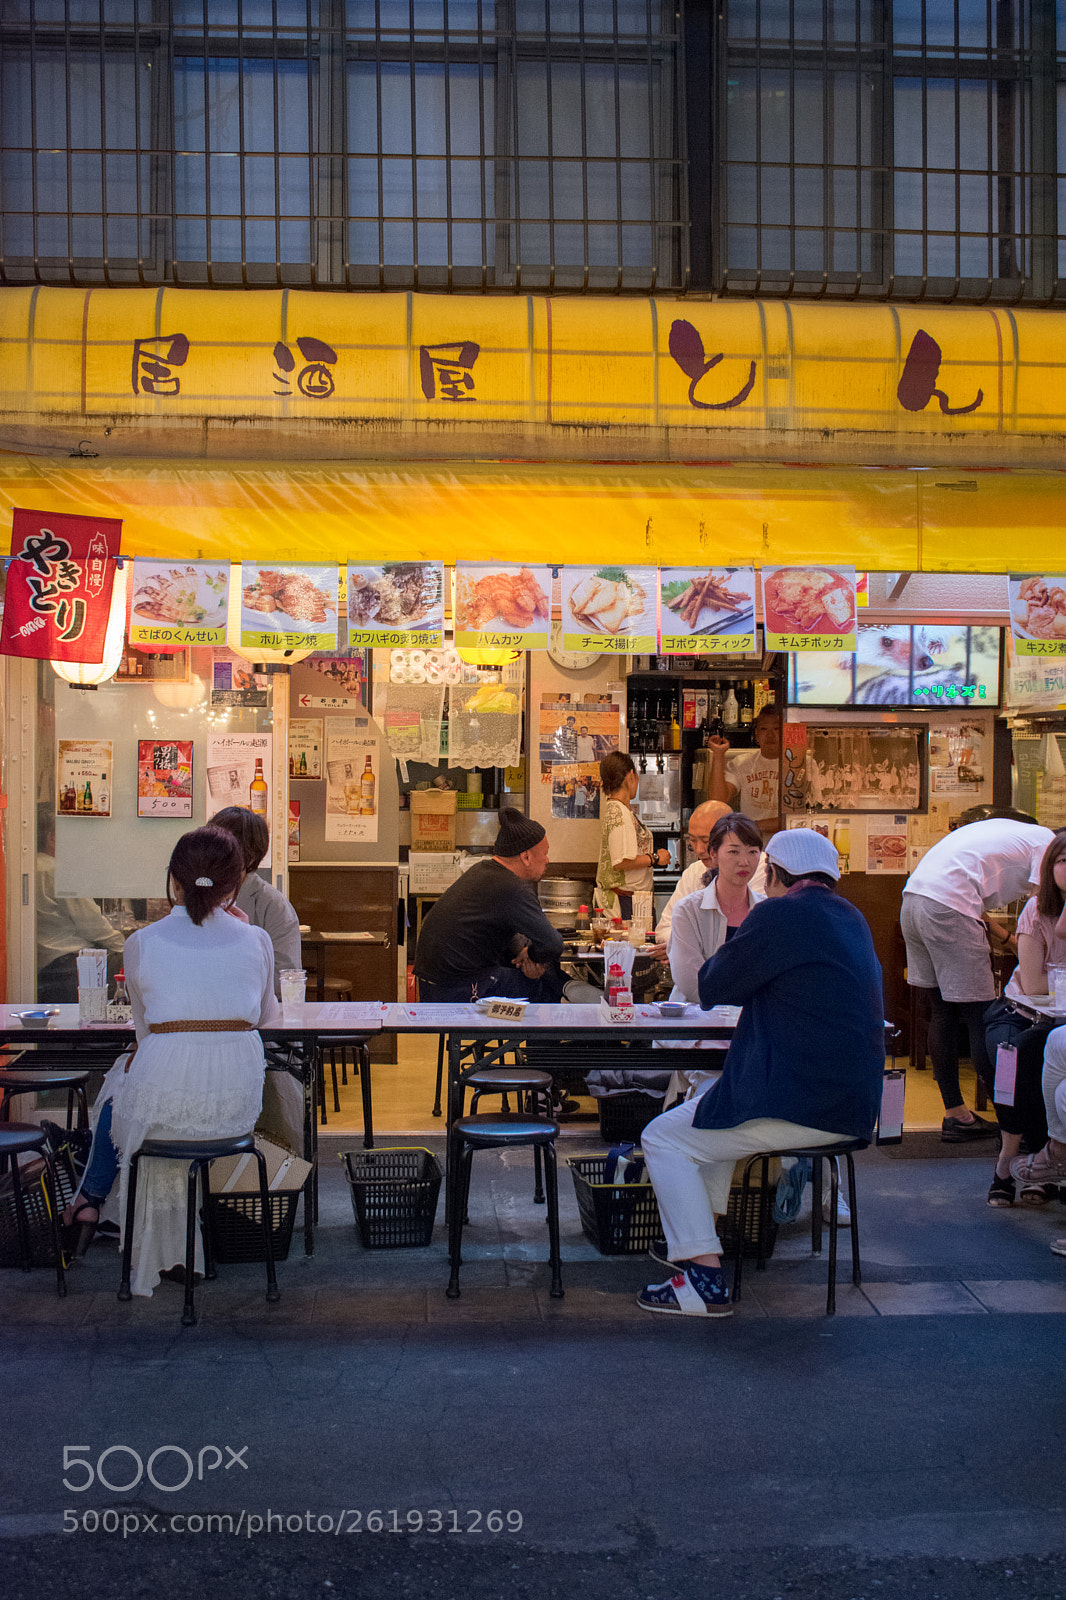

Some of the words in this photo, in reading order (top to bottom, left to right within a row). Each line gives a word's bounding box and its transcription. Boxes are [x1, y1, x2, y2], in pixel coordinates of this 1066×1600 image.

[131, 333, 481, 401] 居酒屋
[90, 541, 105, 588] 味自慢
[18, 528, 86, 642] やきとり
[138, 628, 218, 642] さばのくんせい
[260, 634, 317, 647] ホルモン焼
[352, 632, 439, 645] カワハギの炙り焼き
[478, 634, 524, 646] ハムカツ
[581, 637, 637, 650] チーズ揚げ
[665, 637, 751, 649] ゴボウスティック
[913, 684, 987, 699] ハリネズミ
